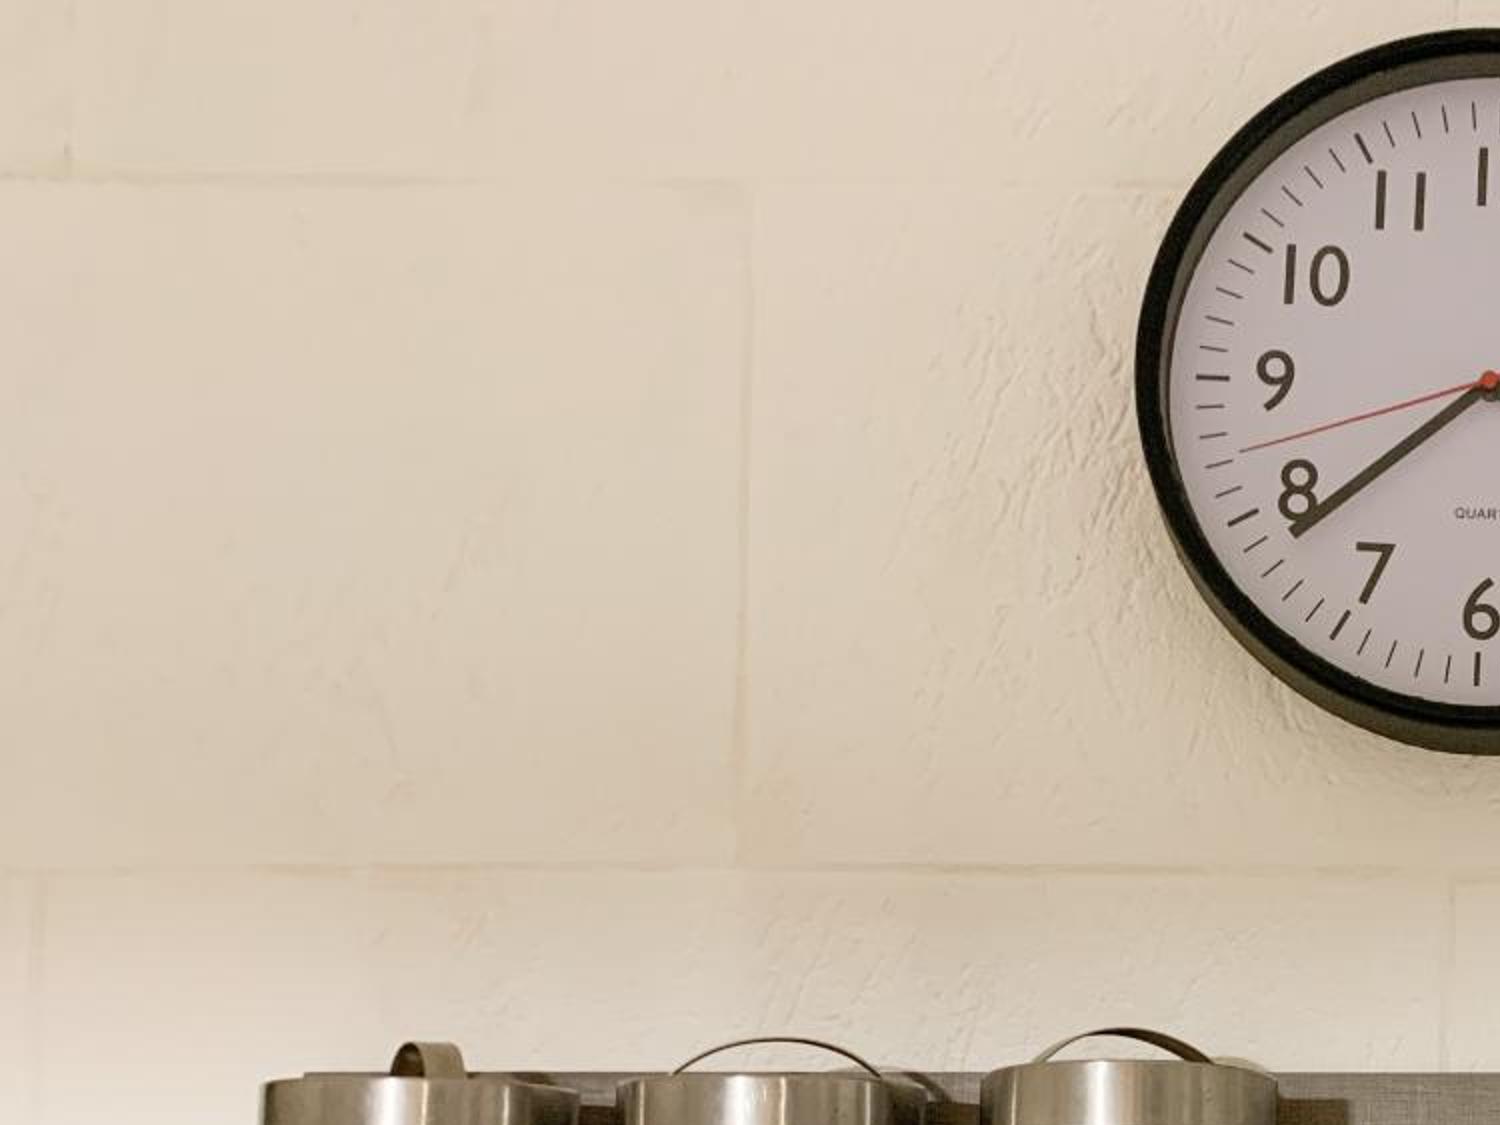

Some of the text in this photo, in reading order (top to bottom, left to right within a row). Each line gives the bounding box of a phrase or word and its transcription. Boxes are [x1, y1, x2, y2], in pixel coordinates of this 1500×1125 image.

[1375, 169, 1427, 232] 11
[1283, 243, 1350, 307] 10
[1256, 349, 1295, 412] 9
[1278, 459, 1319, 521] 8
[1355, 541, 1396, 605] 7
[1462, 577, 1500, 641] 6
